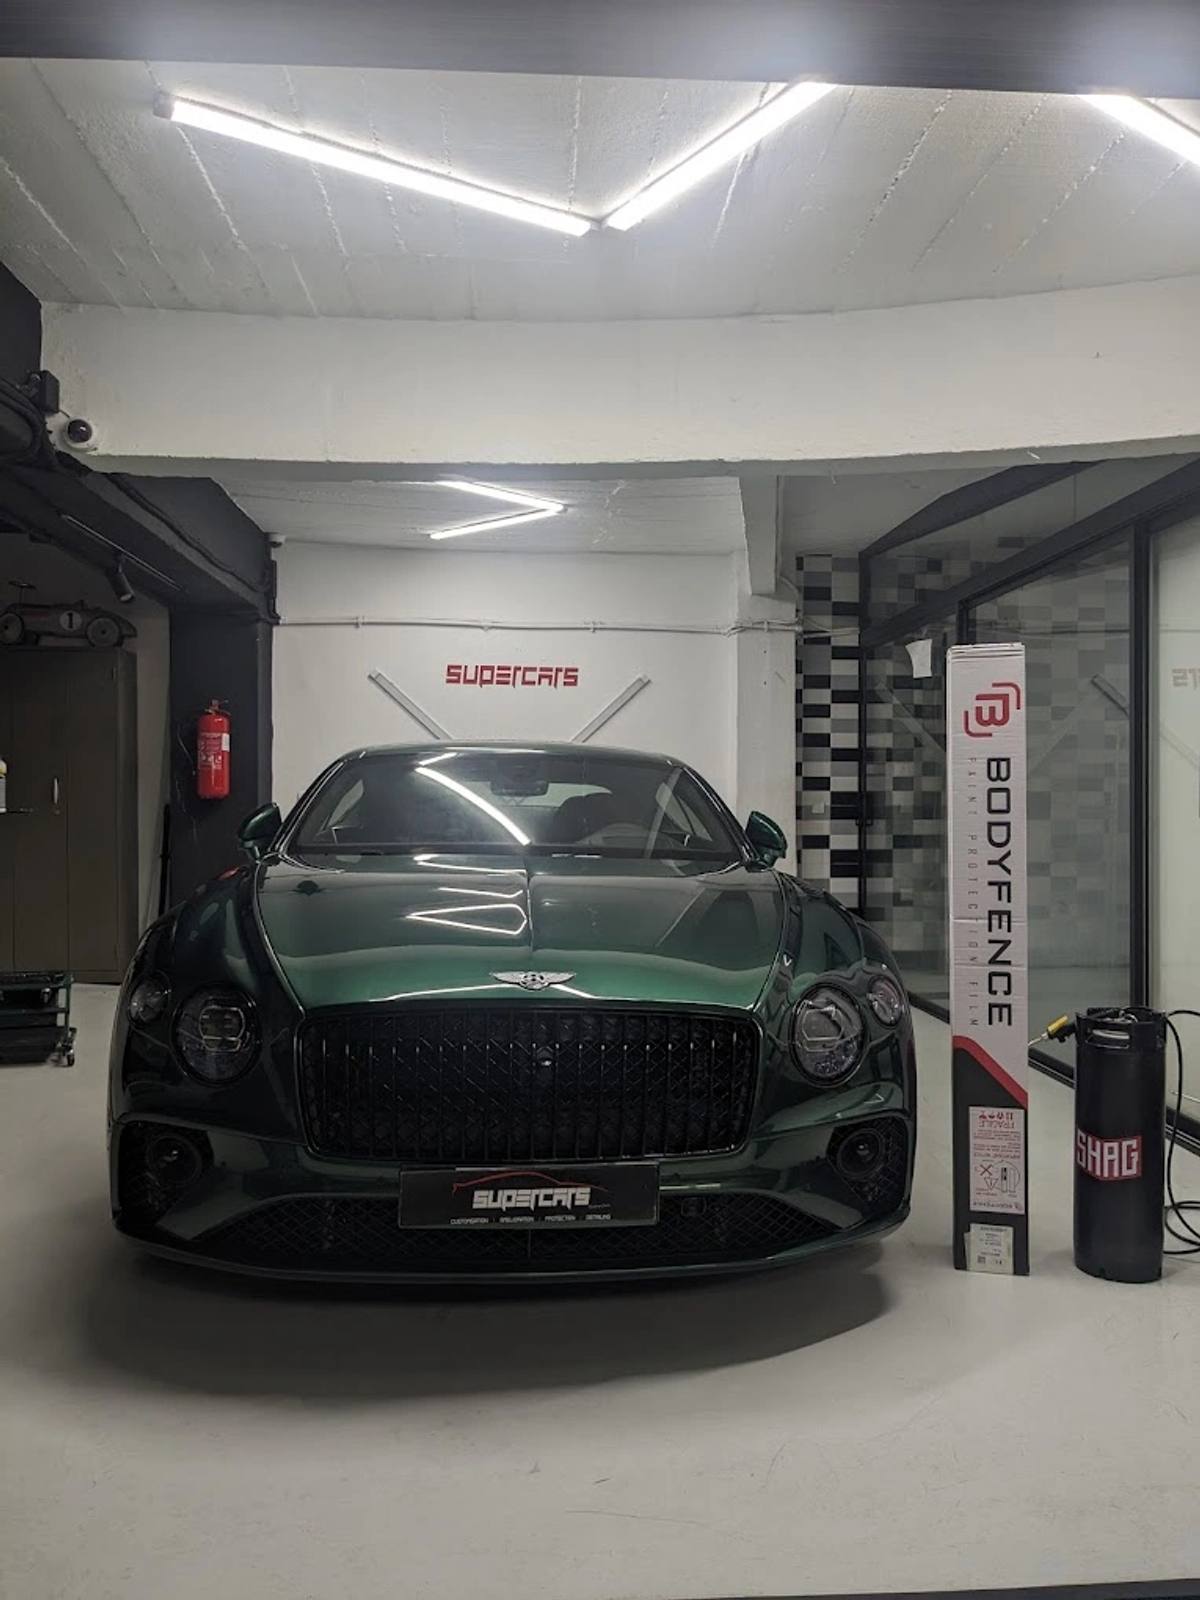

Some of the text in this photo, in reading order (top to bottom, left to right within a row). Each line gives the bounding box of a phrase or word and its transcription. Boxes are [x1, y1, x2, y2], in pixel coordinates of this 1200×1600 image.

[66, 612, 73, 629] 1
[967, 757, 977, 815] PAINT
[987, 757, 1012, 1027] BODYFENCE
[968, 981, 979, 1026] FILM
[1077, 1128, 1139, 1178] SHAG
